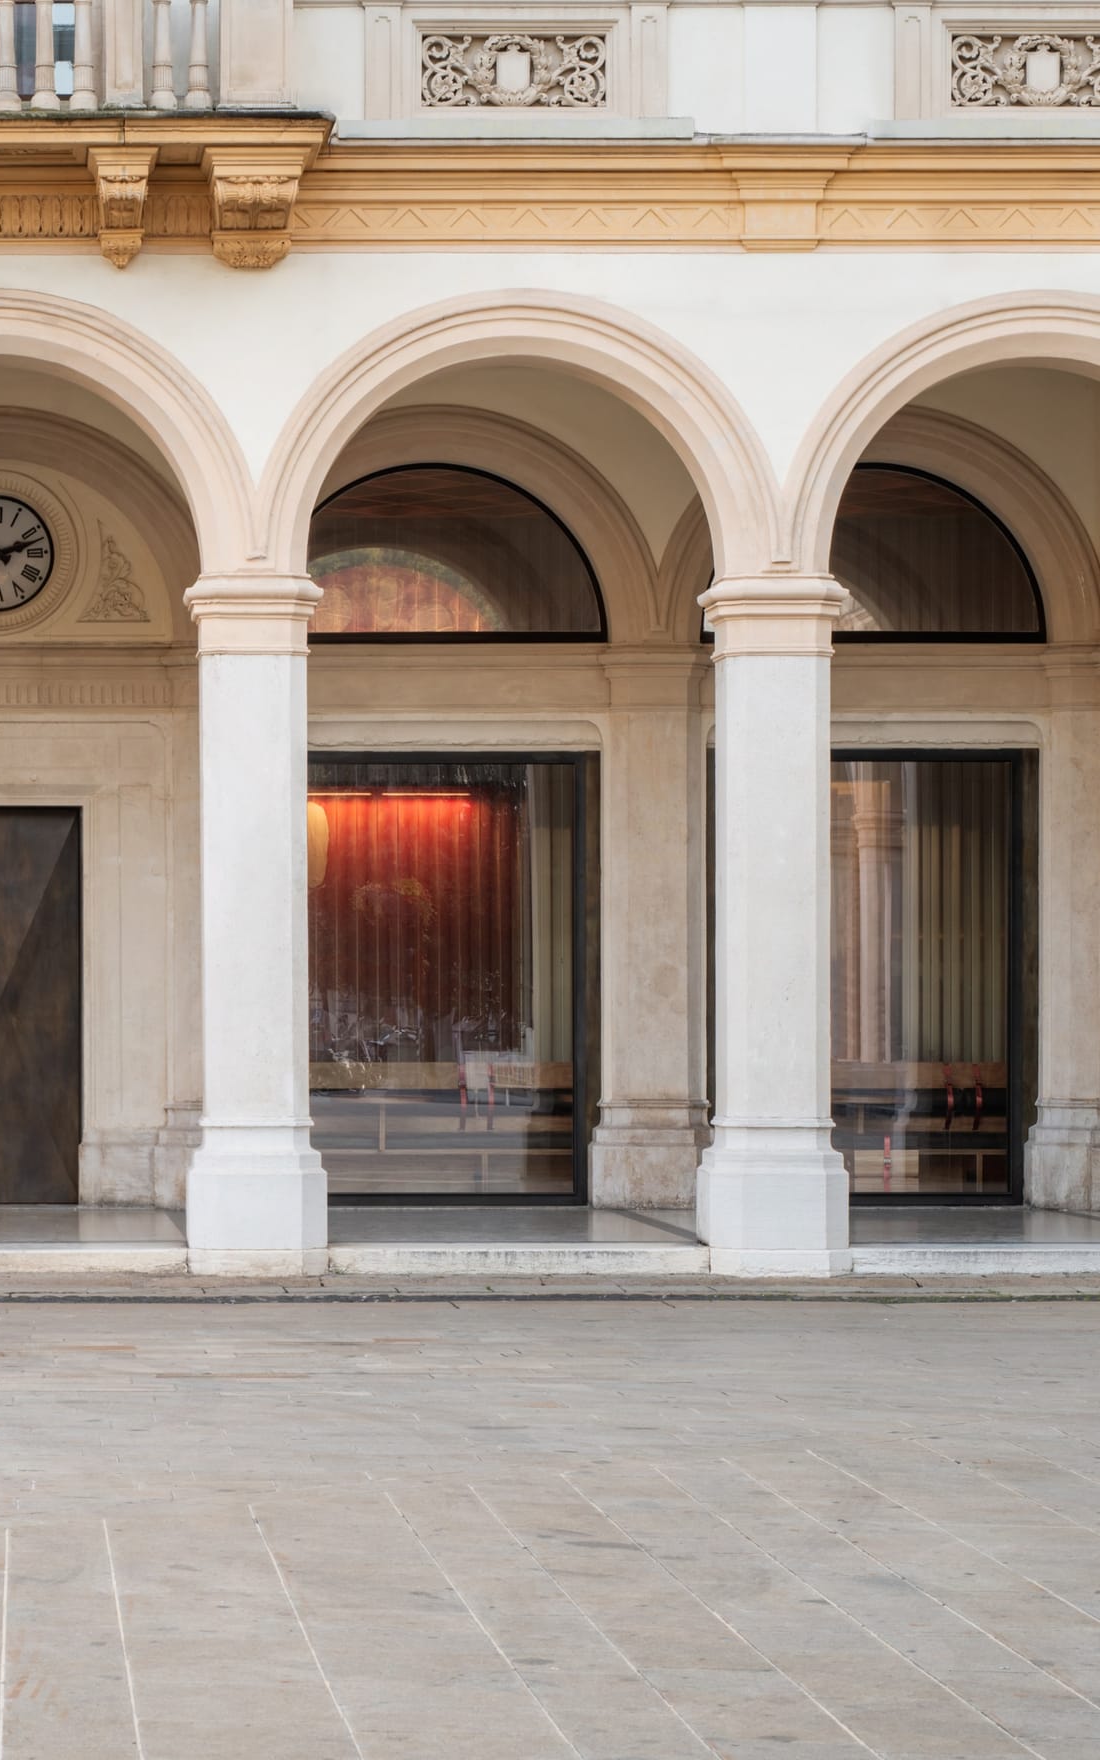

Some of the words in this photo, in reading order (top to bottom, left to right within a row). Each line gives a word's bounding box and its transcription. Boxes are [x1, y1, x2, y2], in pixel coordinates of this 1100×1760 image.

[10, 512, 19, 527] I
[21, 527, 37, 540] II
[27, 547, 43, 558] III
[12, 581, 24, 597] V
